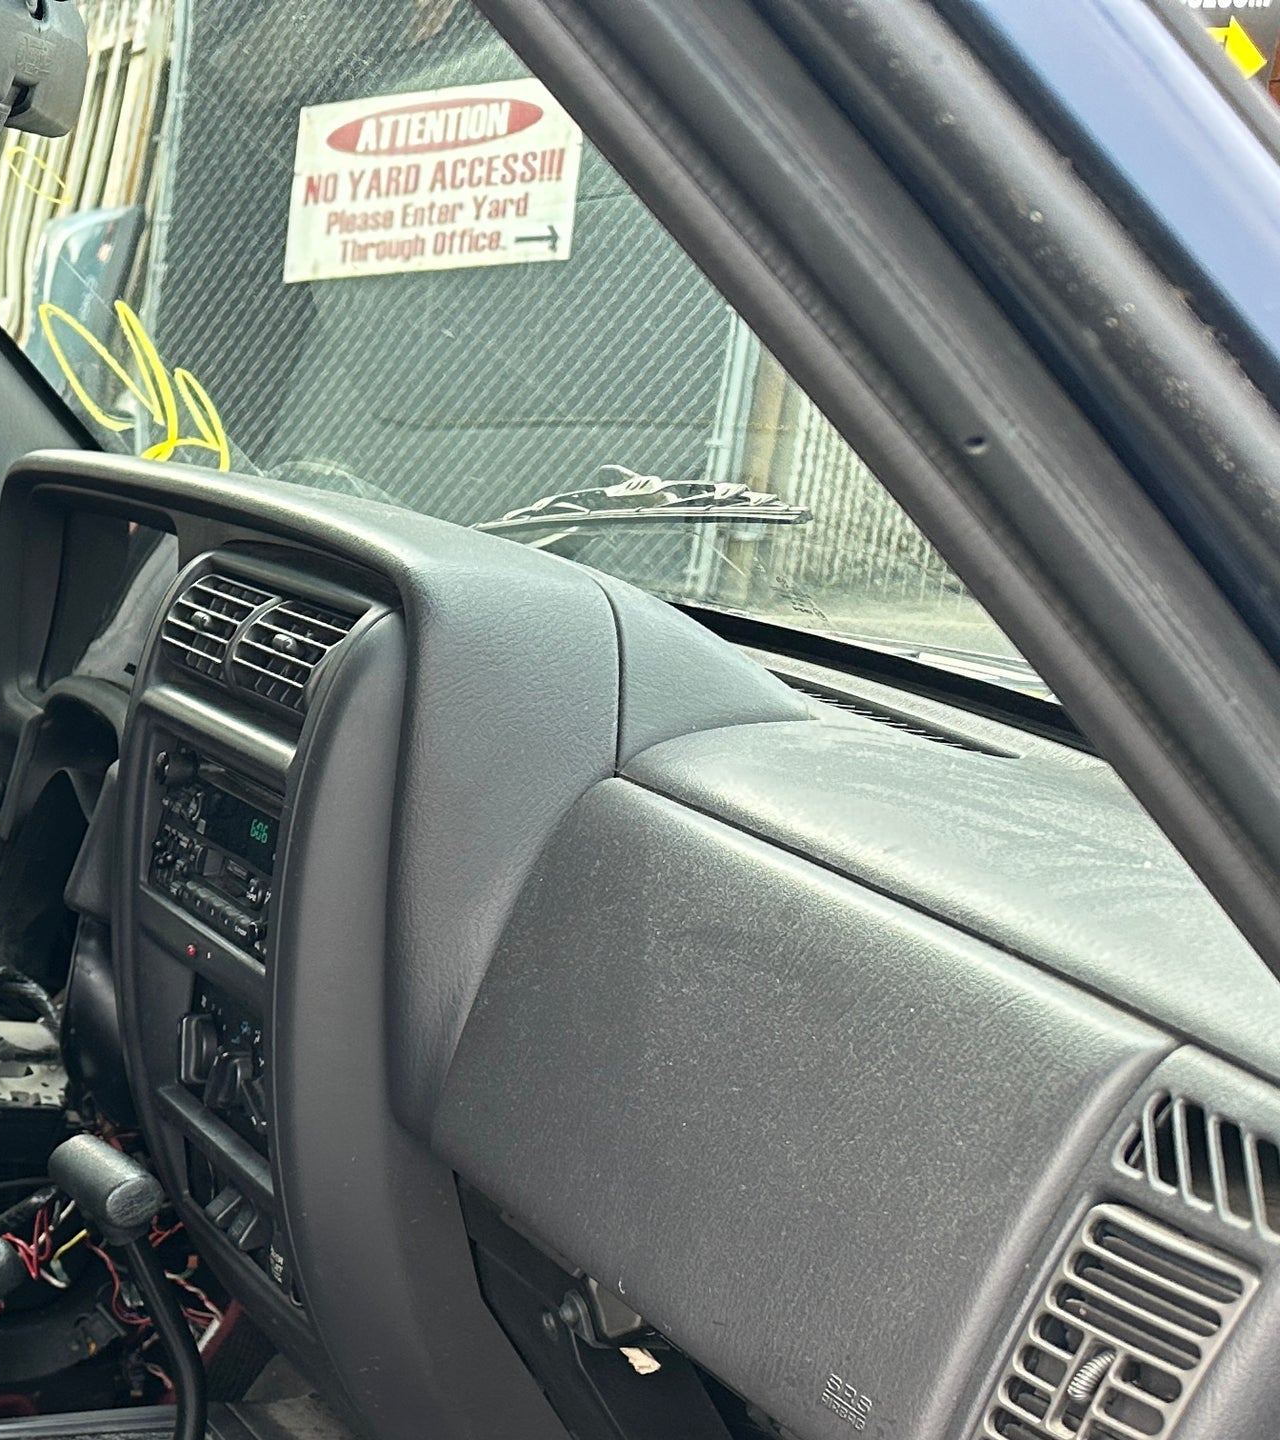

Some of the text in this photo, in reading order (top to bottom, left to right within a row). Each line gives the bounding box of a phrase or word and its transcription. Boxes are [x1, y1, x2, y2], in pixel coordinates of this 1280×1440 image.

[354, 100, 511, 153] ATTENTION
[303, 147, 566, 207] NO YARD ACCESS!!!
[326, 192, 530, 236] Please Enter Yard
[340, 228, 426, 264] Through
[821, 1391, 866, 1431] AIRBAG
[826, 1373, 873, 1413] SRS
